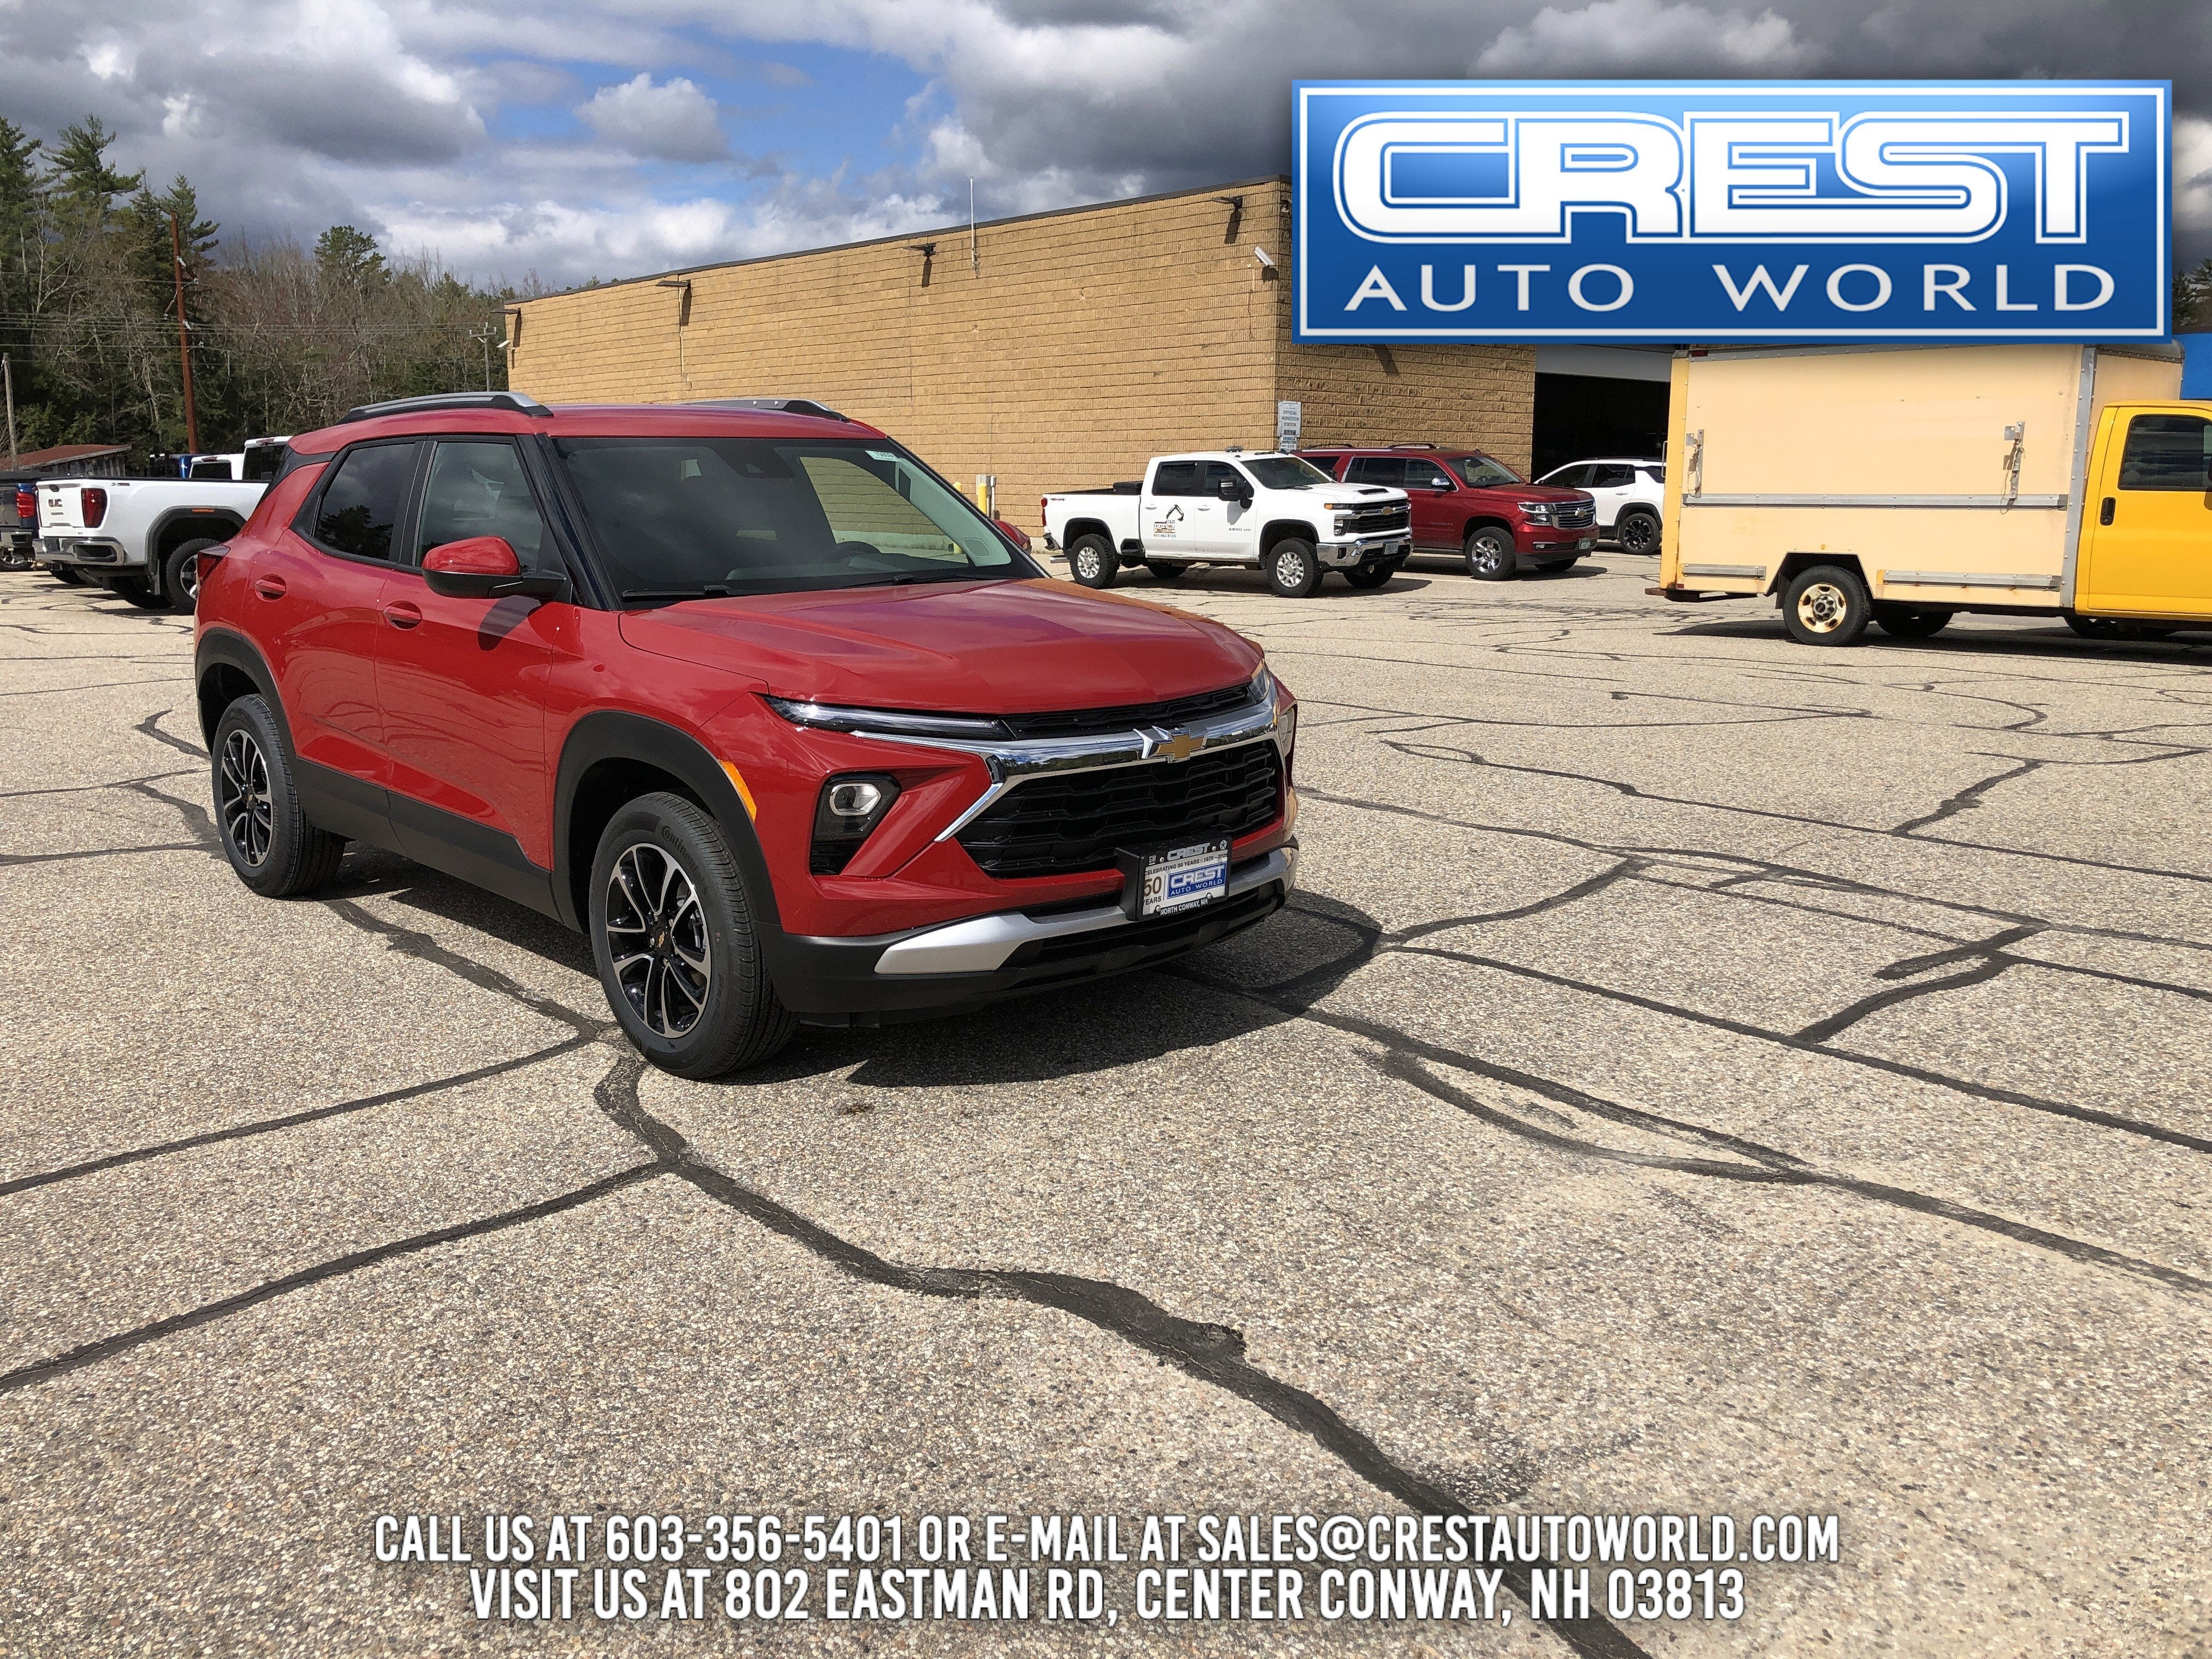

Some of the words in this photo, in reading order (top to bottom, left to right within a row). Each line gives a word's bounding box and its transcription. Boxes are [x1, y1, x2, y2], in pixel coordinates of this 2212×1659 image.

[1149, 855, 1156, 864] GM
[1167, 842, 1211, 861] CREST
[1144, 864, 1176, 876] CELEBRATING
[1184, 859, 1200, 867] YEARS
[1170, 866, 1225, 889] CREST
[1144, 876, 1162, 897] 50
[1170, 886, 1191, 896] AUTO
[1195, 879, 1223, 890] WORLD
[1160, 906, 1178, 916] NORTH
